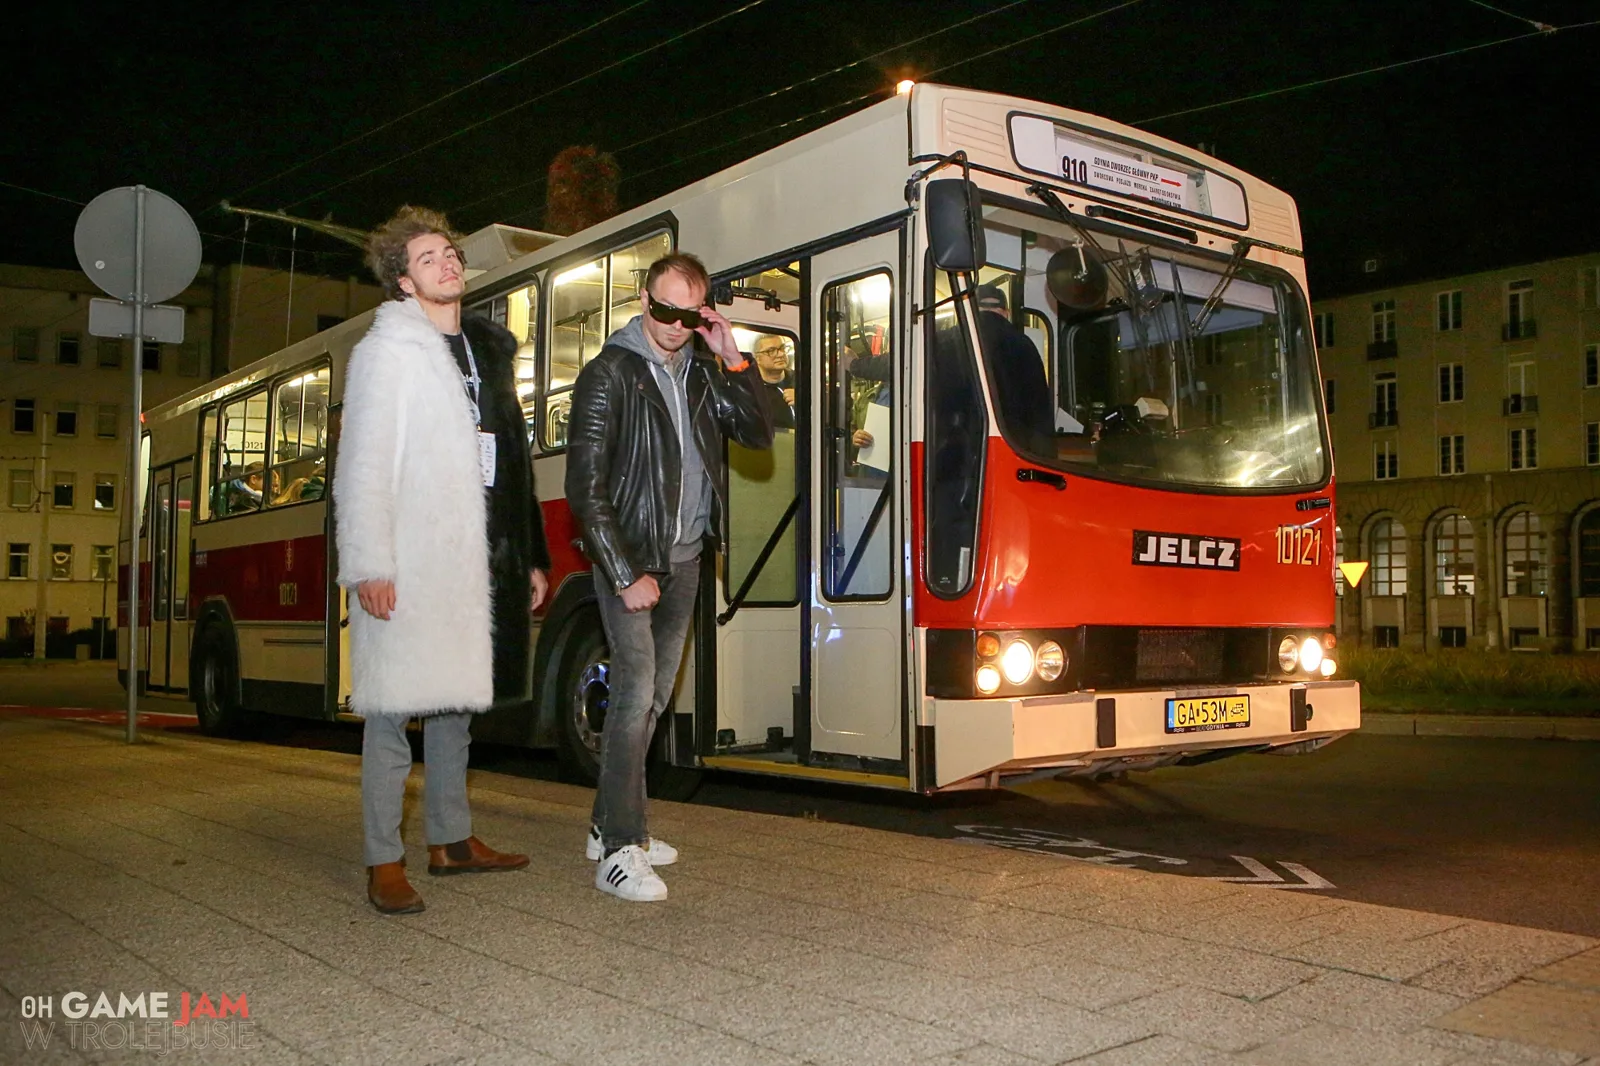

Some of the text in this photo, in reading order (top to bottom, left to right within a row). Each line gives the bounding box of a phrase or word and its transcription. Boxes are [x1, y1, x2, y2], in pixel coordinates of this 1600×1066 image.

[1062, 155, 1087, 184] 910
[1094, 157, 1159, 181] GDYNIA DWORZEC GŁÓWNY PKP
[241, 440, 263, 450] 0121
[1139, 536, 1236, 567] JELCZ
[1275, 526, 1321, 566] 10121
